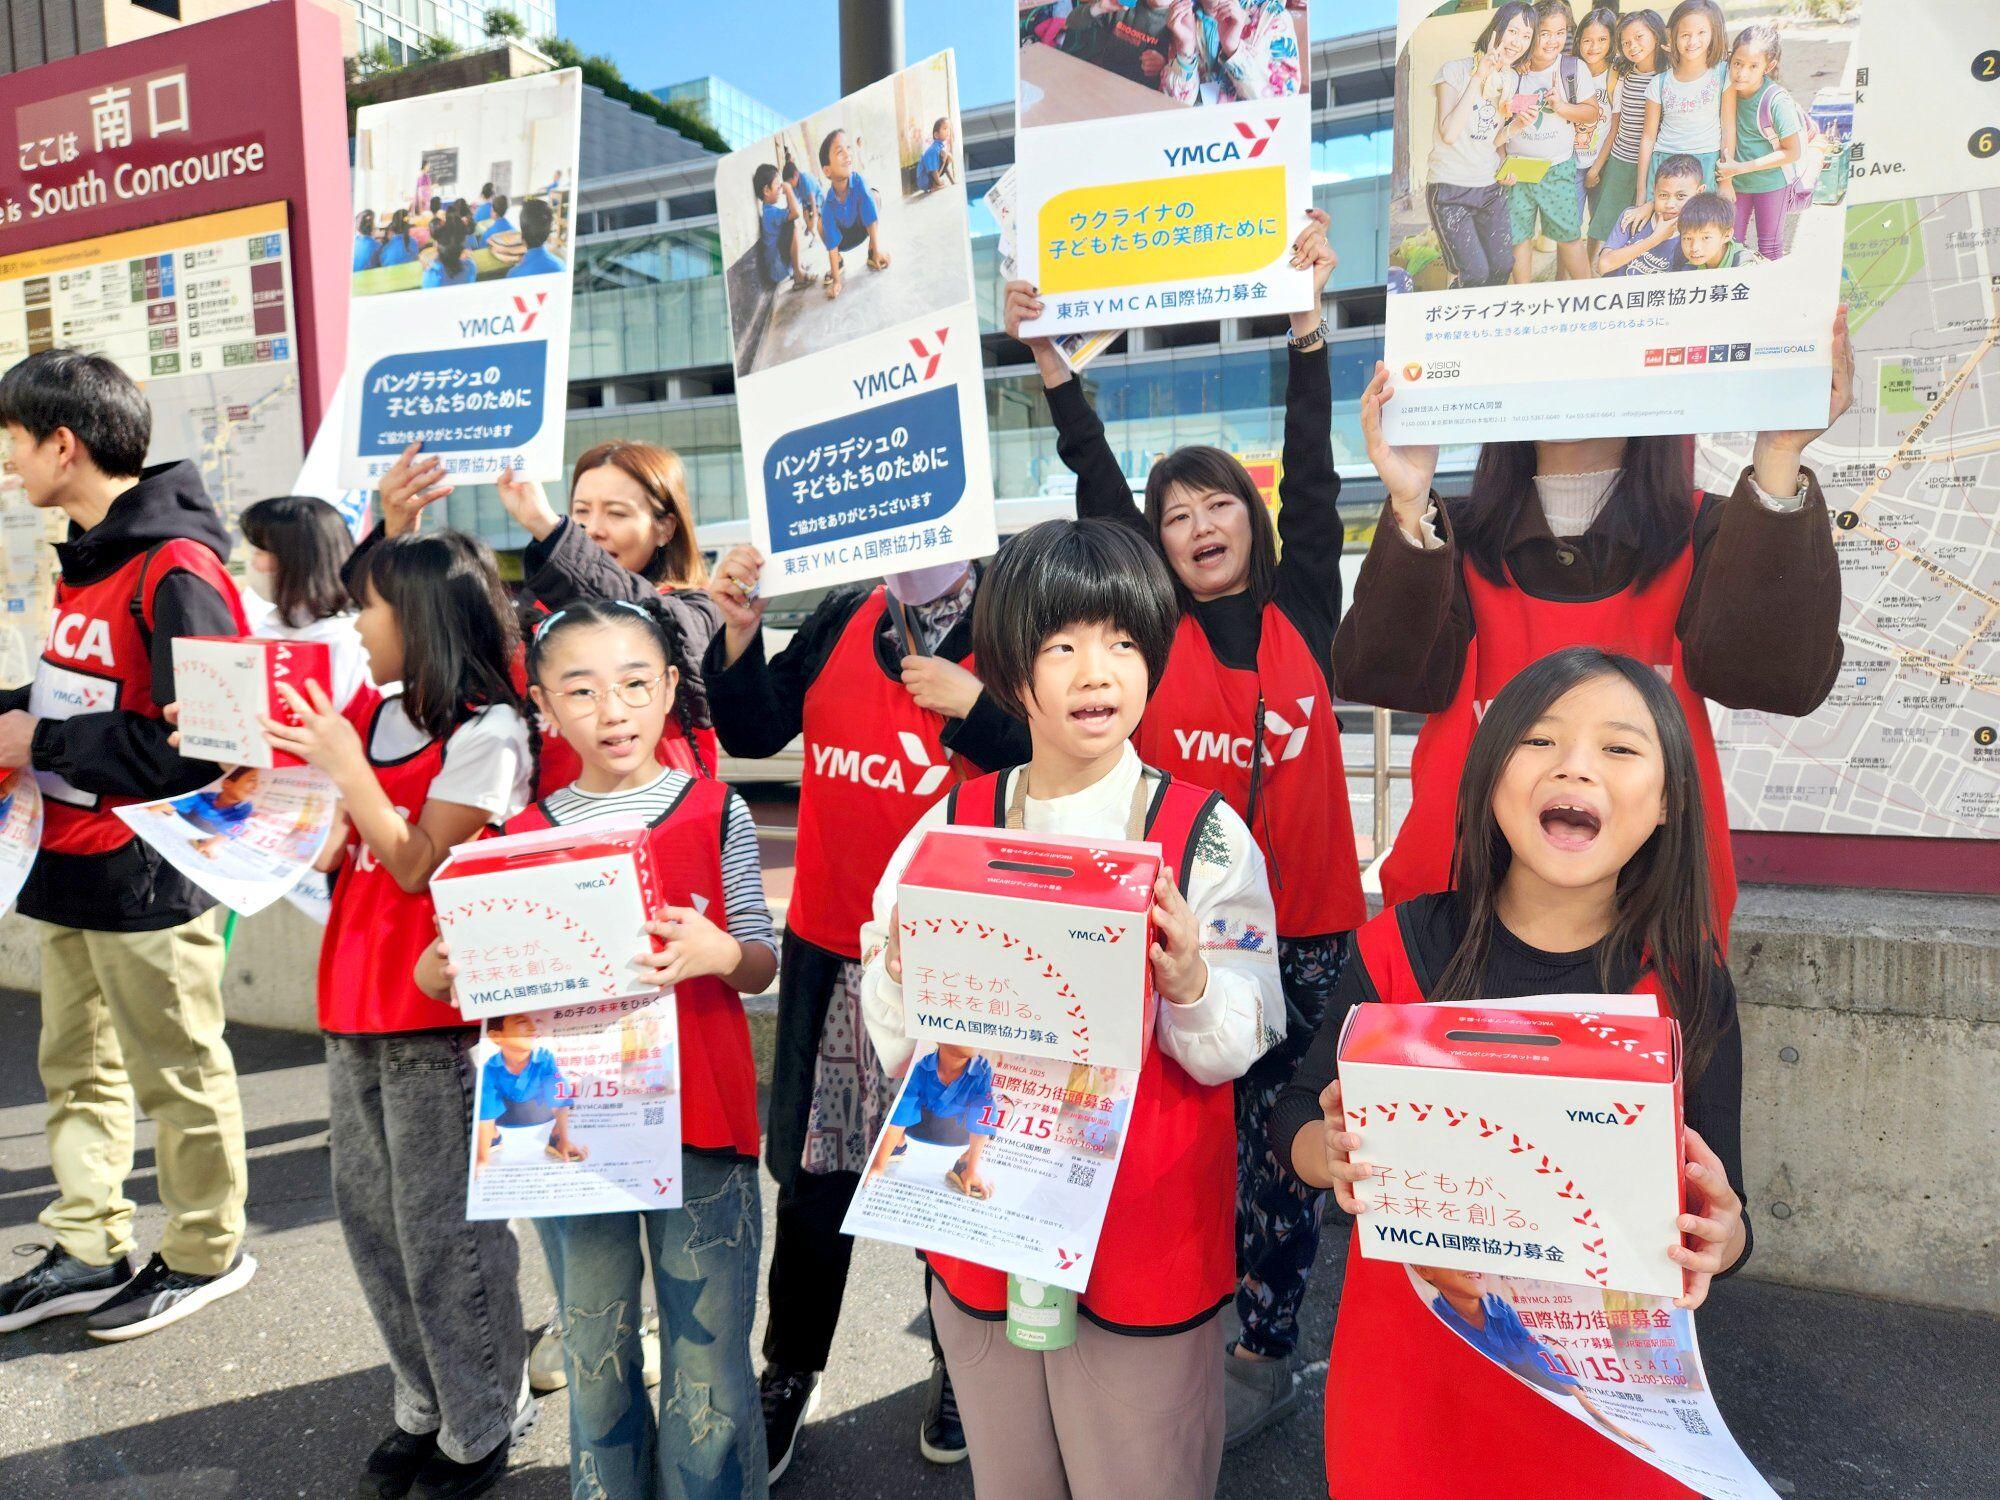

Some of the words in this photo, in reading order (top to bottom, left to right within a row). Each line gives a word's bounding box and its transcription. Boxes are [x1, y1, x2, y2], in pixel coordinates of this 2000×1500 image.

[1982, 56, 1995, 76] 2
[20, 131, 80, 171] ここは
[89, 72, 190, 154] 南口
[1163, 141, 1241, 167] YMCA
[1978, 133, 1992, 153] 6
[29, 169, 107, 218] South
[114, 142, 265, 200] Concourse
[1870, 161, 1906, 177] Ave.
[1069, 201, 1195, 231] ウクライナの
[1049, 217, 1277, 260] 子どもたちの笑顔ために
[1056, 282, 1268, 320] 東京YMCA国際協力募金
[1425, 283, 1750, 323] ポジティブネットYMCA国際協力募金
[459, 315, 516, 338] YMCA
[373, 366, 501, 394] バングラデシュの
[853, 362, 918, 399] YMCA
[1426, 370, 1460, 379] 2030
[1427, 361, 1461, 370] VISION
[386, 388, 532, 418] 子どもたちのために
[1442, 401, 1503, 412] 日本YMCA同盟
[377, 424, 513, 445] ご協力をありがとうございます
[774, 427, 909, 480] バングラデシュの
[792, 447, 949, 504] 子どもたちのために
[788, 492, 932, 537] ご協力をありがとうございます
[1843, 514, 1852, 526] 7
[784, 525, 953, 575] 東京YMCA国際協力募金
[1173, 729, 1275, 768] YMCA
[1981, 730, 1990, 742] 6
[811, 743, 905, 793] YMCA
[575, 879, 606, 890] YMCA
[1068, 929, 1106, 943] YMCA
[461, 940, 550, 965] 子どもが、
[466, 957, 573, 984] 未来を創る。
[915, 967, 1020, 997] 子どもが、
[470, 977, 590, 1005] YMCA国際協力募金
[917, 988, 1043, 1021] 未来を創る。
[553, 996, 659, 1020] あの子の未来をひらく
[917, 1013, 1059, 1045] YMCA国際協力募金
[990, 1073, 1115, 1113] 国際協力街頭募金
[977, 1106, 1053, 1139] 11/15
[1566, 1109, 1619, 1125] YMCA
[1371, 1165, 1507, 1200] 子どもが、
[1374, 1193, 1540, 1232] 未来を創る。
[1375, 1224, 1565, 1263] YMCA国際協力募金
[1554, 1295, 1573, 1304] 2025
[1517, 1309, 1672, 1330] 国際協力街頭募金
[1538, 1350, 1625, 1384] 11/15
[1631, 1374, 1688, 1386] 12:00-16:00
